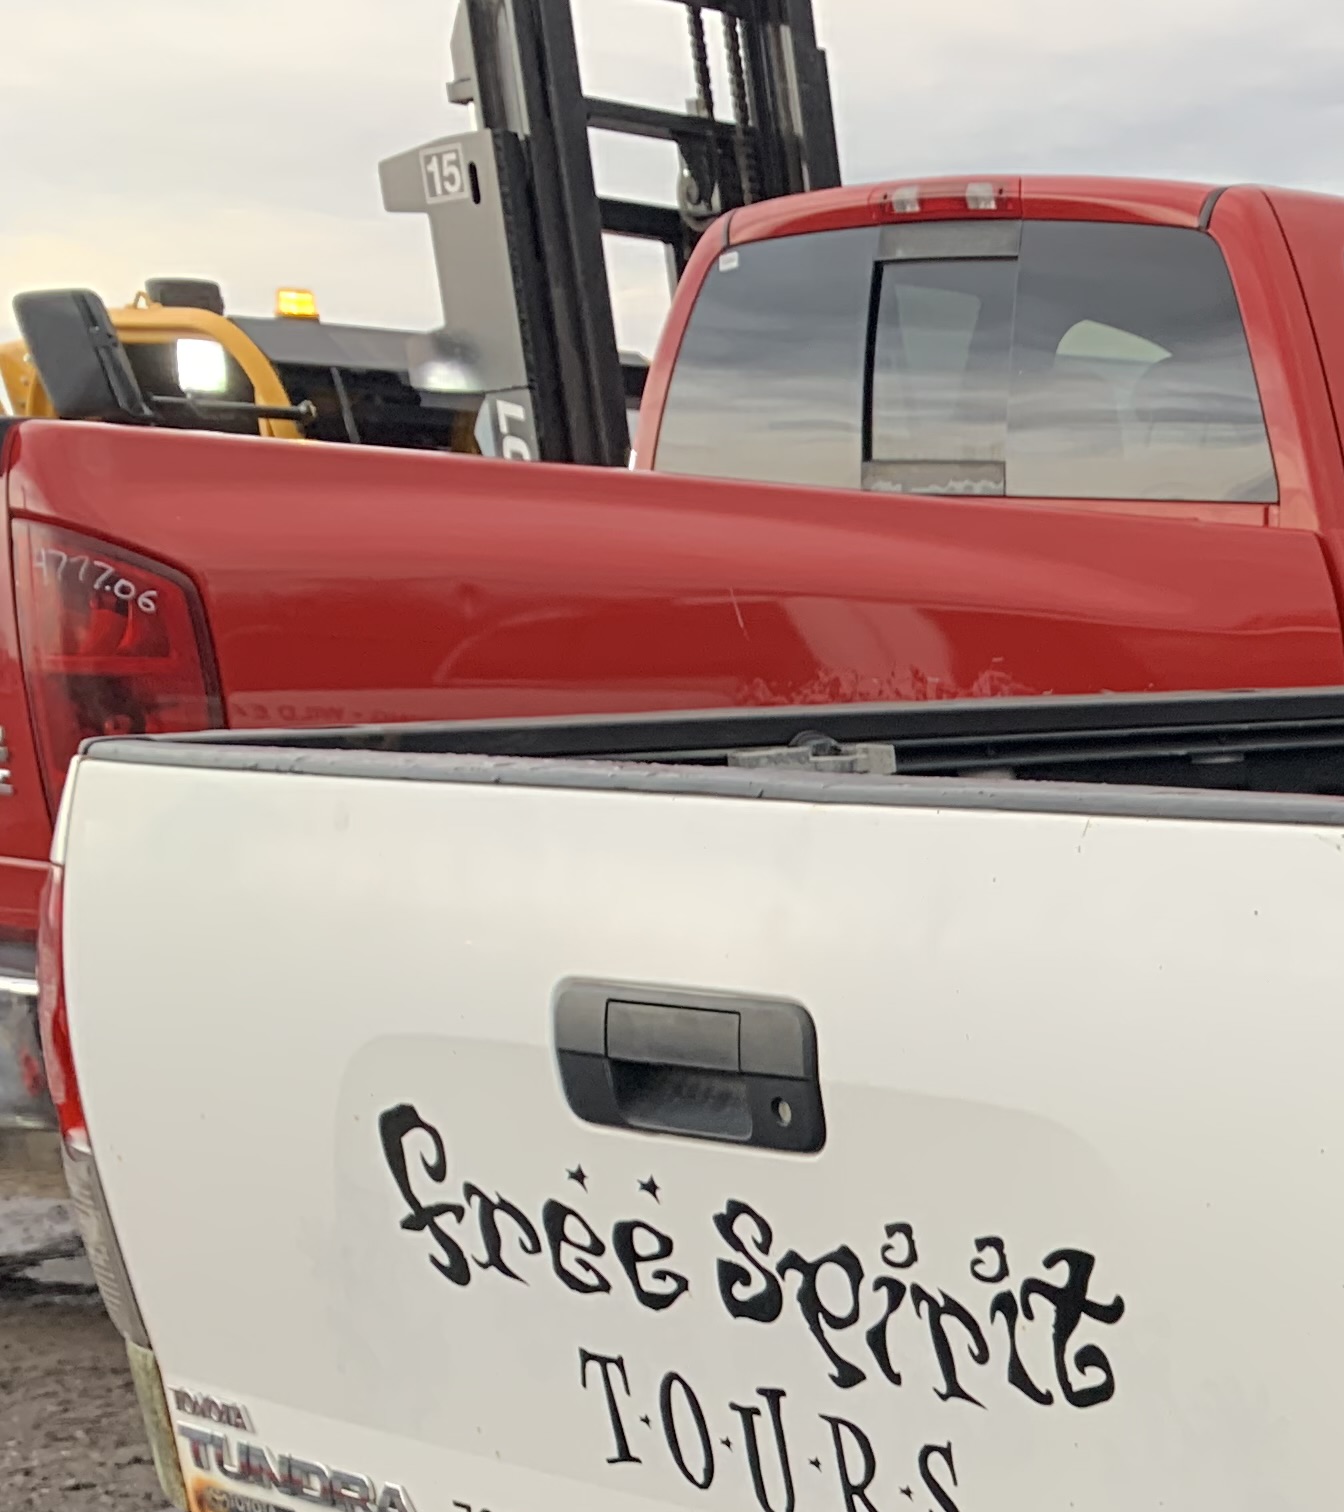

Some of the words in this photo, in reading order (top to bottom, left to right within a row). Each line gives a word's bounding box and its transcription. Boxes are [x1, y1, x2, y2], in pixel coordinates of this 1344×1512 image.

[427, 153, 463, 196] 15
[33, 548, 158, 613] 4777.06
[168, 1385, 256, 1434] TOYOTA
